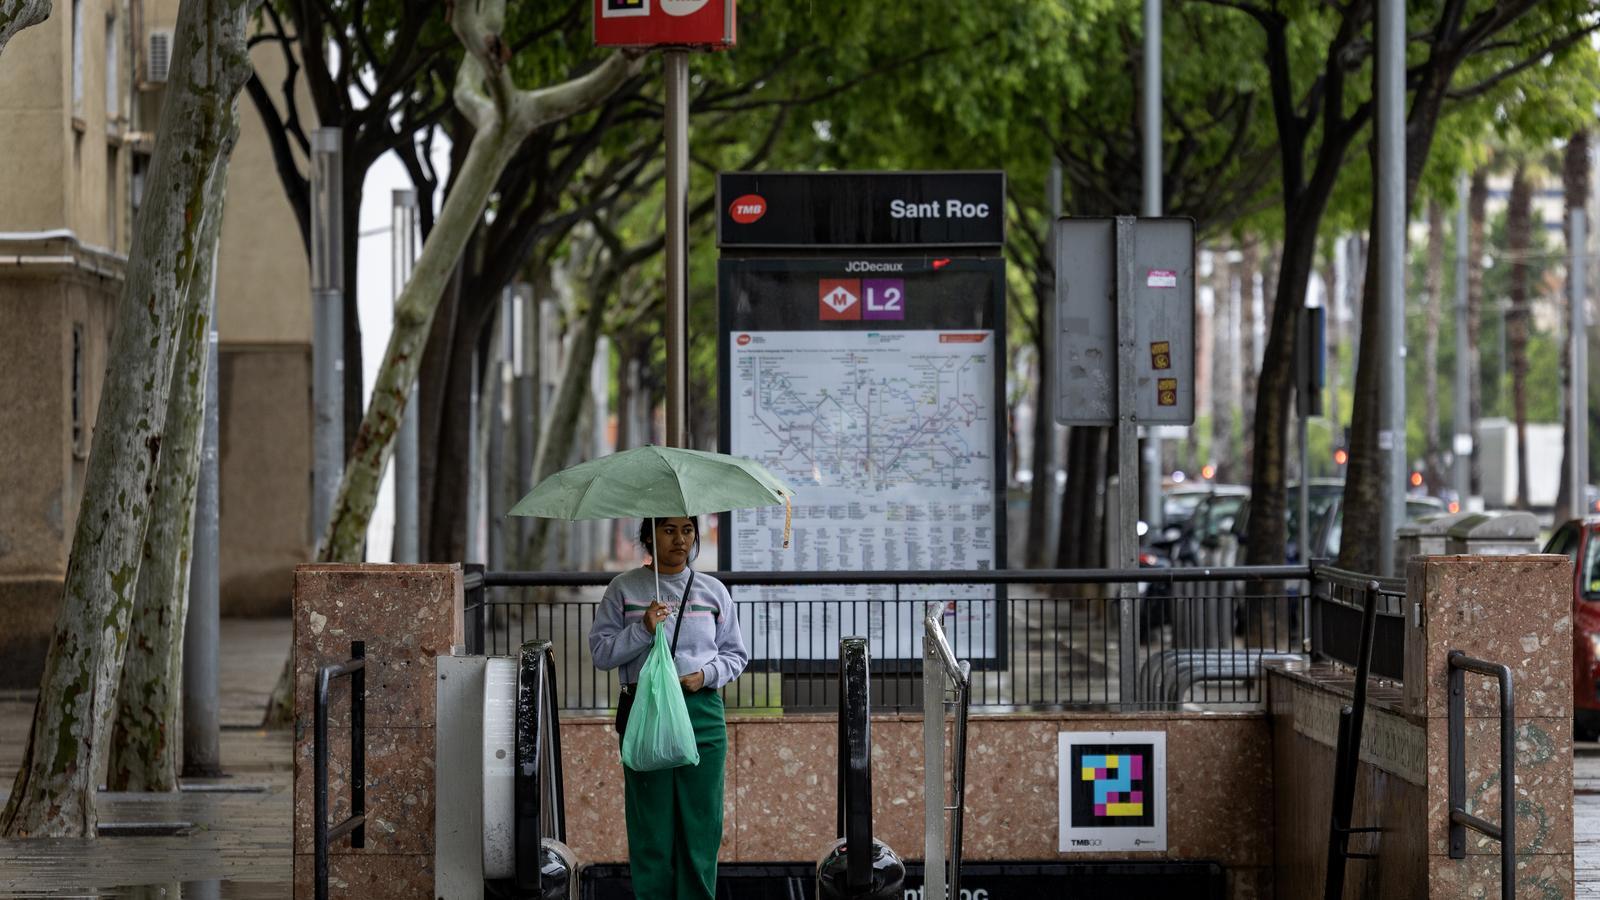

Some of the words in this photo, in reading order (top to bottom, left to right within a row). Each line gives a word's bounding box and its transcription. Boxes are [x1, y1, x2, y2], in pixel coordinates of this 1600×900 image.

[737, 204, 762, 215] TMB
[890, 199, 940, 219] Sant
[946, 200, 989, 219] Roc
[845, 261, 903, 272] JCDecaux
[833, 293, 847, 306] M
[867, 287, 901, 311] L2
